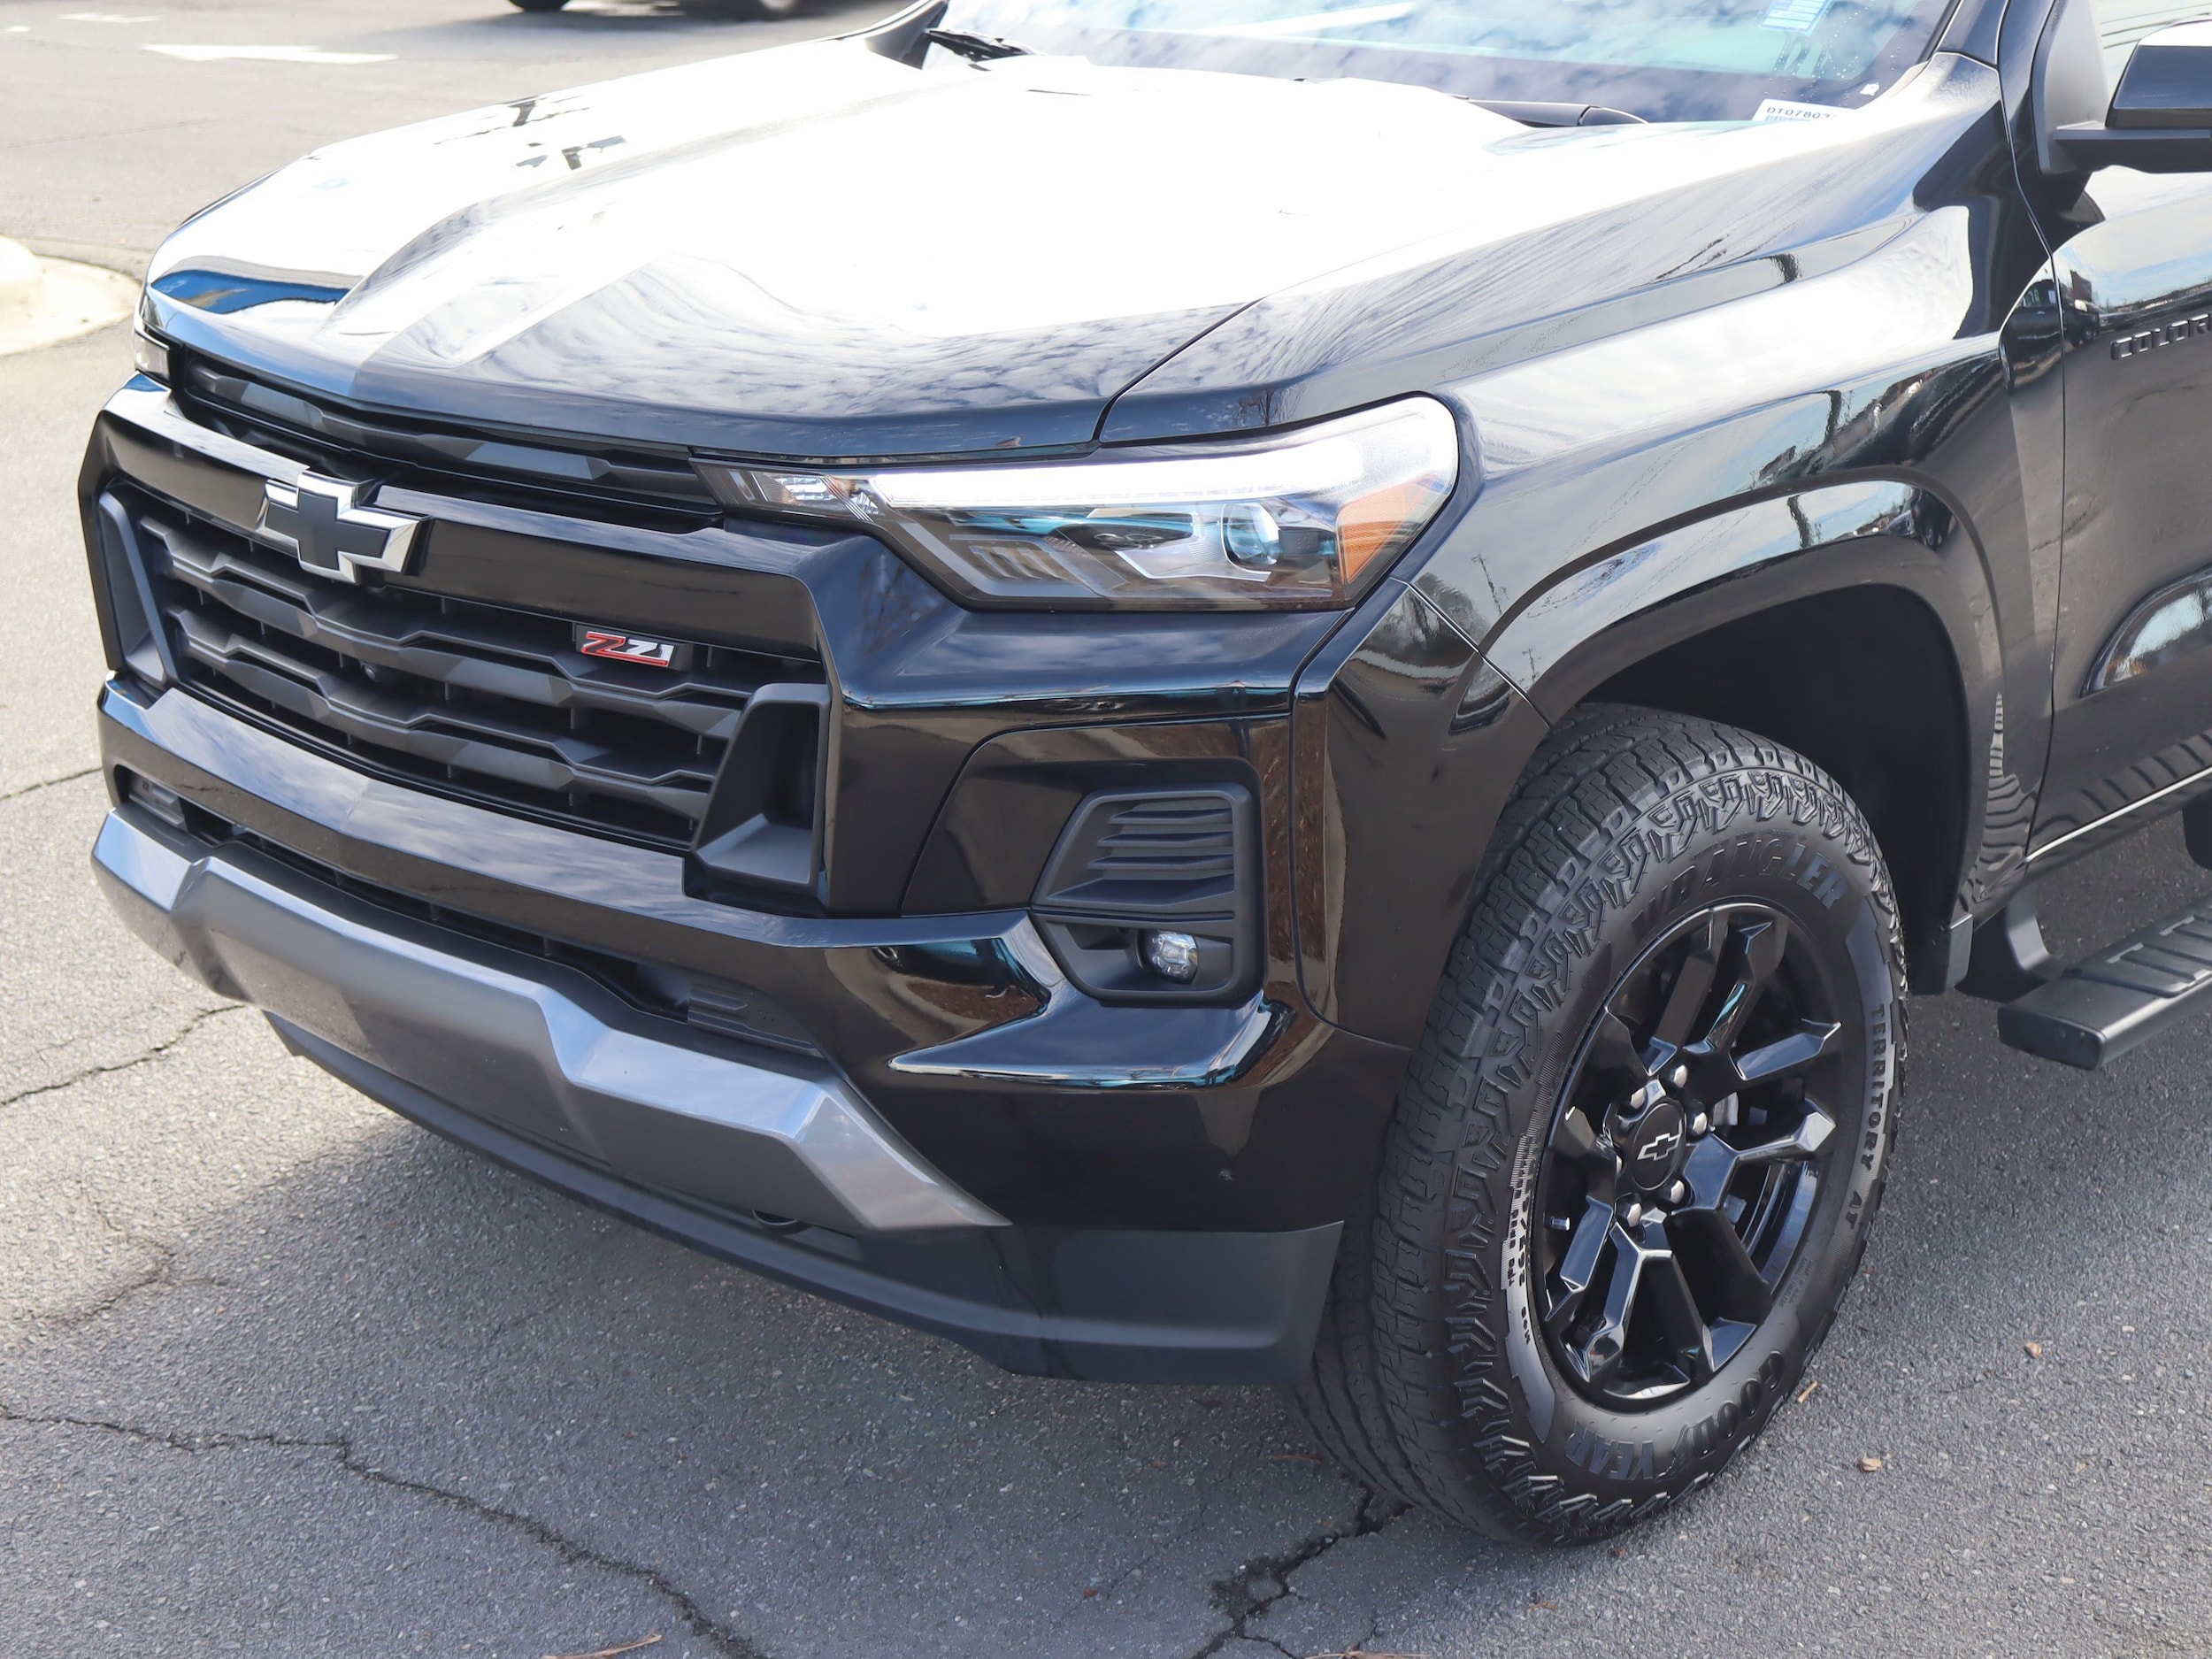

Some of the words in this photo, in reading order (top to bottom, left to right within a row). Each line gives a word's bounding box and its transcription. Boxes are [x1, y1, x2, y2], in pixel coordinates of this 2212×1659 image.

[581, 631, 674, 668] Z71
[1631, 838, 1849, 933] WRANGLER
[1862, 1003, 1886, 1171] TERRITORY
